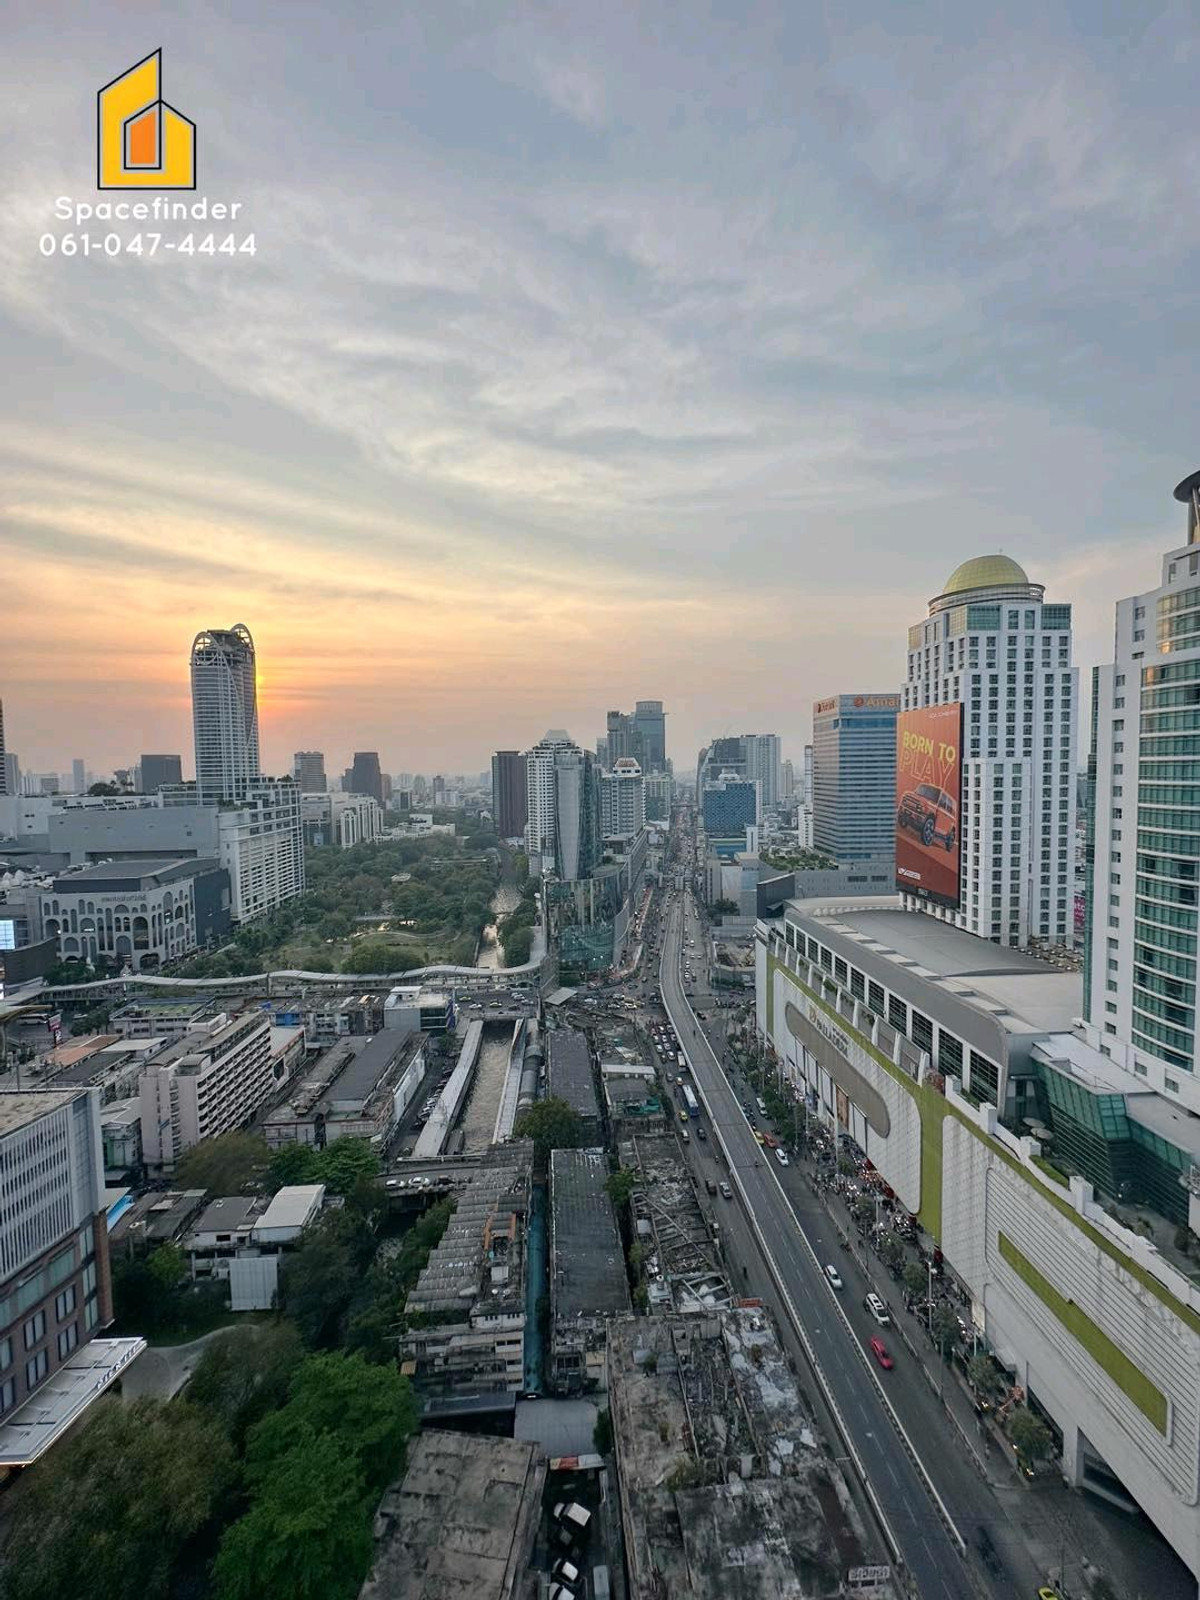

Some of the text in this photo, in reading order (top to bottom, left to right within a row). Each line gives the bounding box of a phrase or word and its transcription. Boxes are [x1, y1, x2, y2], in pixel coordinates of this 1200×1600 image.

[903, 731, 956, 763] BORN TO
[900, 747, 955, 790] PLAY
